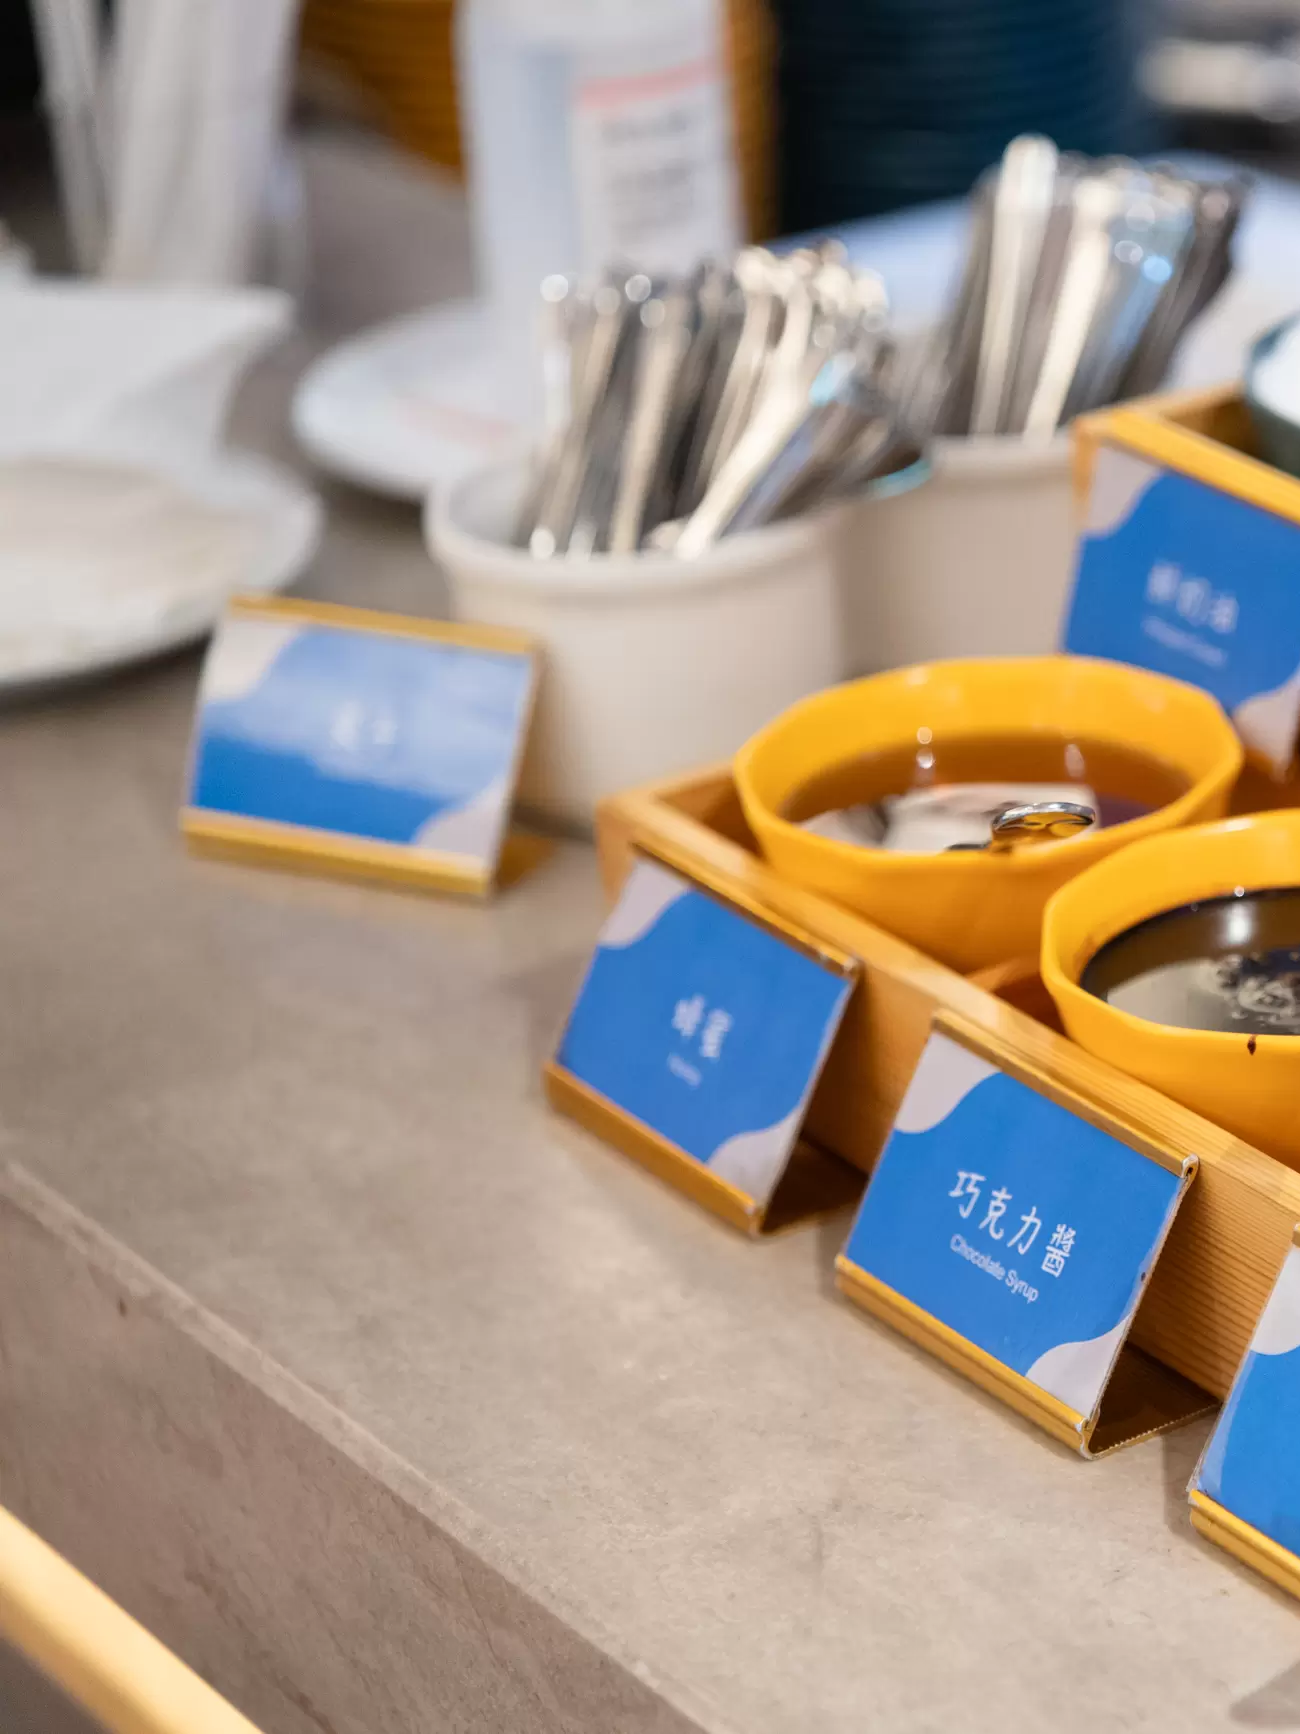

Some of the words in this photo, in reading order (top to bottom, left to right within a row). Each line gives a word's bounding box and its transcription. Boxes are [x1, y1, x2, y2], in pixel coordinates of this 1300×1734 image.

[948, 1170, 1077, 1278] 巧克力醬
[950, 1233, 1006, 1280] Chocolate
[1004, 1269, 1039, 1304] Syrup
